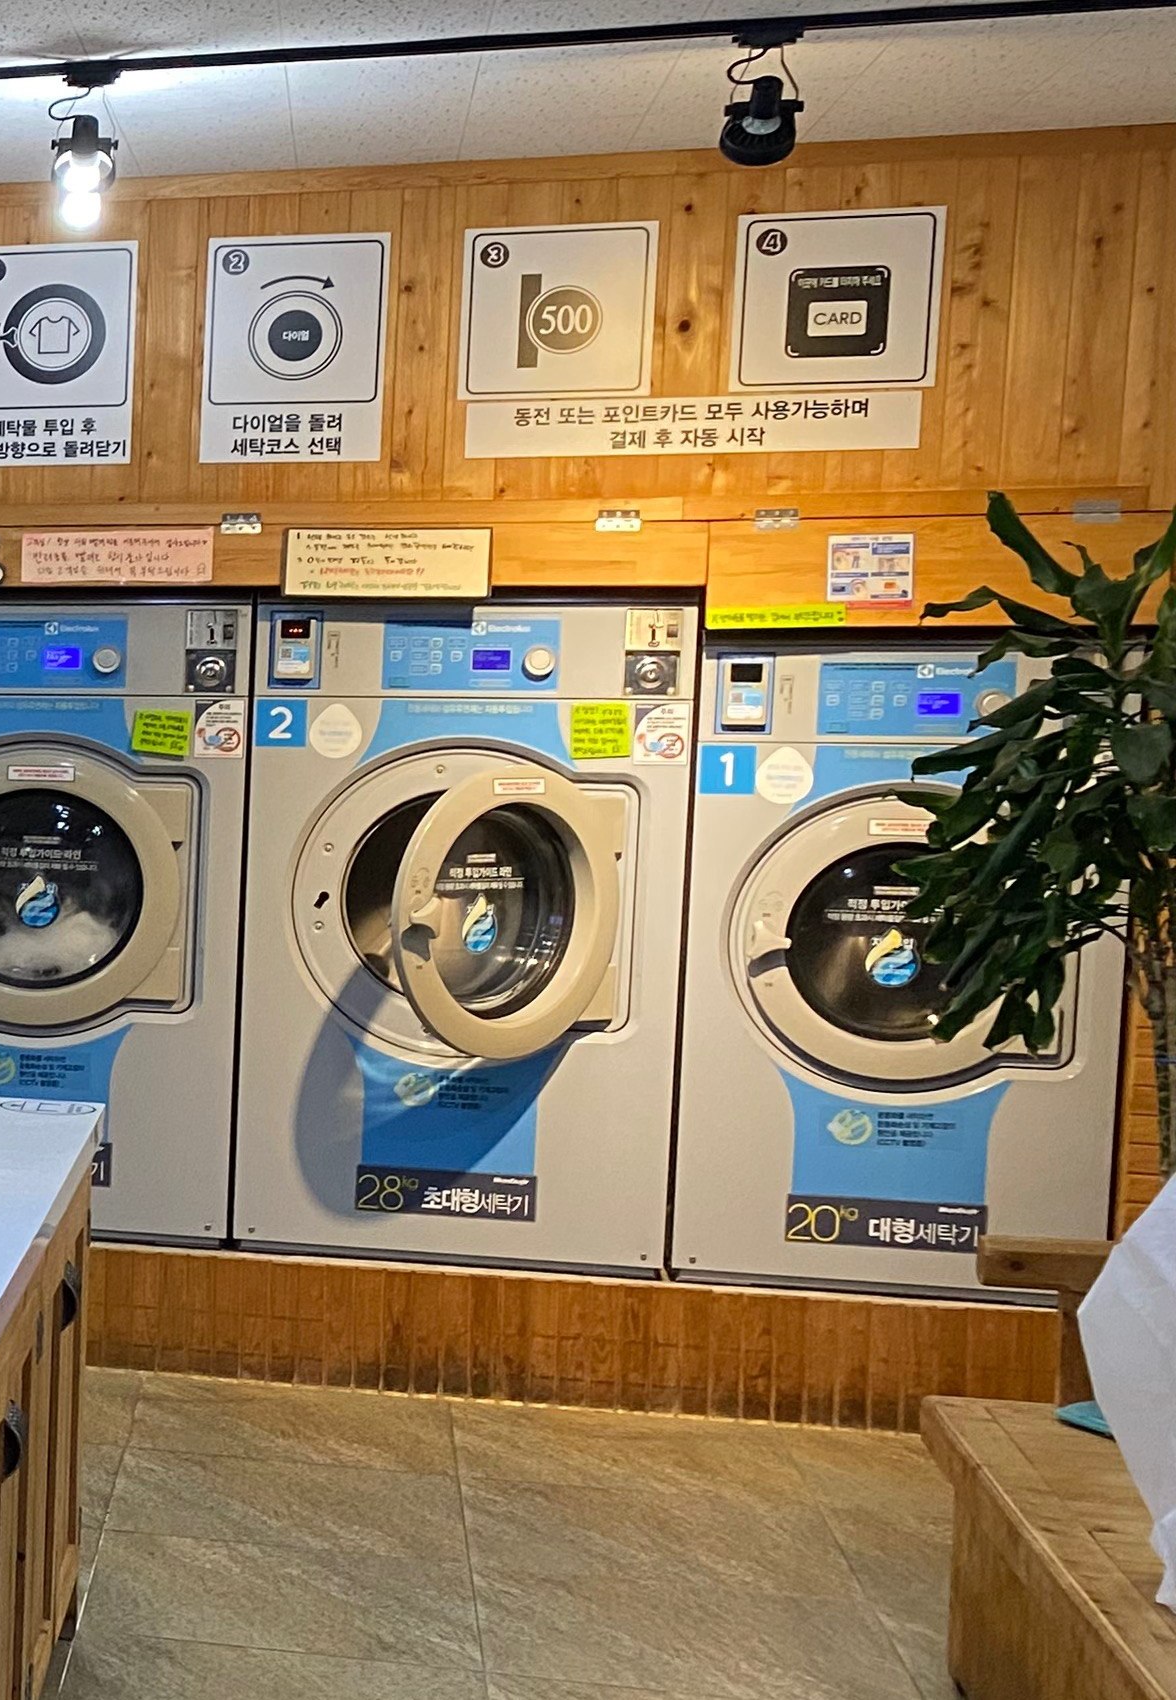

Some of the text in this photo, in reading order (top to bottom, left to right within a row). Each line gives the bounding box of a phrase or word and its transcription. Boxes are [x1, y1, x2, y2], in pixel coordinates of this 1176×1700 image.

[762, 231, 782, 252] 4
[228, 251, 244, 273] 2
[486, 243, 505, 265] 3
[539, 304, 593, 336] 500
[813, 311, 862, 325] CARD
[282, 329, 310, 342] 다이얼
[232, 413, 342, 433] 다이얼을 돌려
[514, 398, 870, 427] 동전 또는 포인트카드 모두 사용가능하며
[43, 418, 74, 436] 투입
[80, 417, 97, 435] 후
[610, 426, 765, 449] 결제 후 자동 시작
[63, 439, 127, 458] 돌려닫기
[231, 437, 342, 456] 세탁코스 선택
[268, 706, 294, 740] 2
[719, 751, 735, 787] 1
[421, 1187, 529, 1216] 초대형세탁기
[868, 1218, 979, 1247] 대형세탁기
